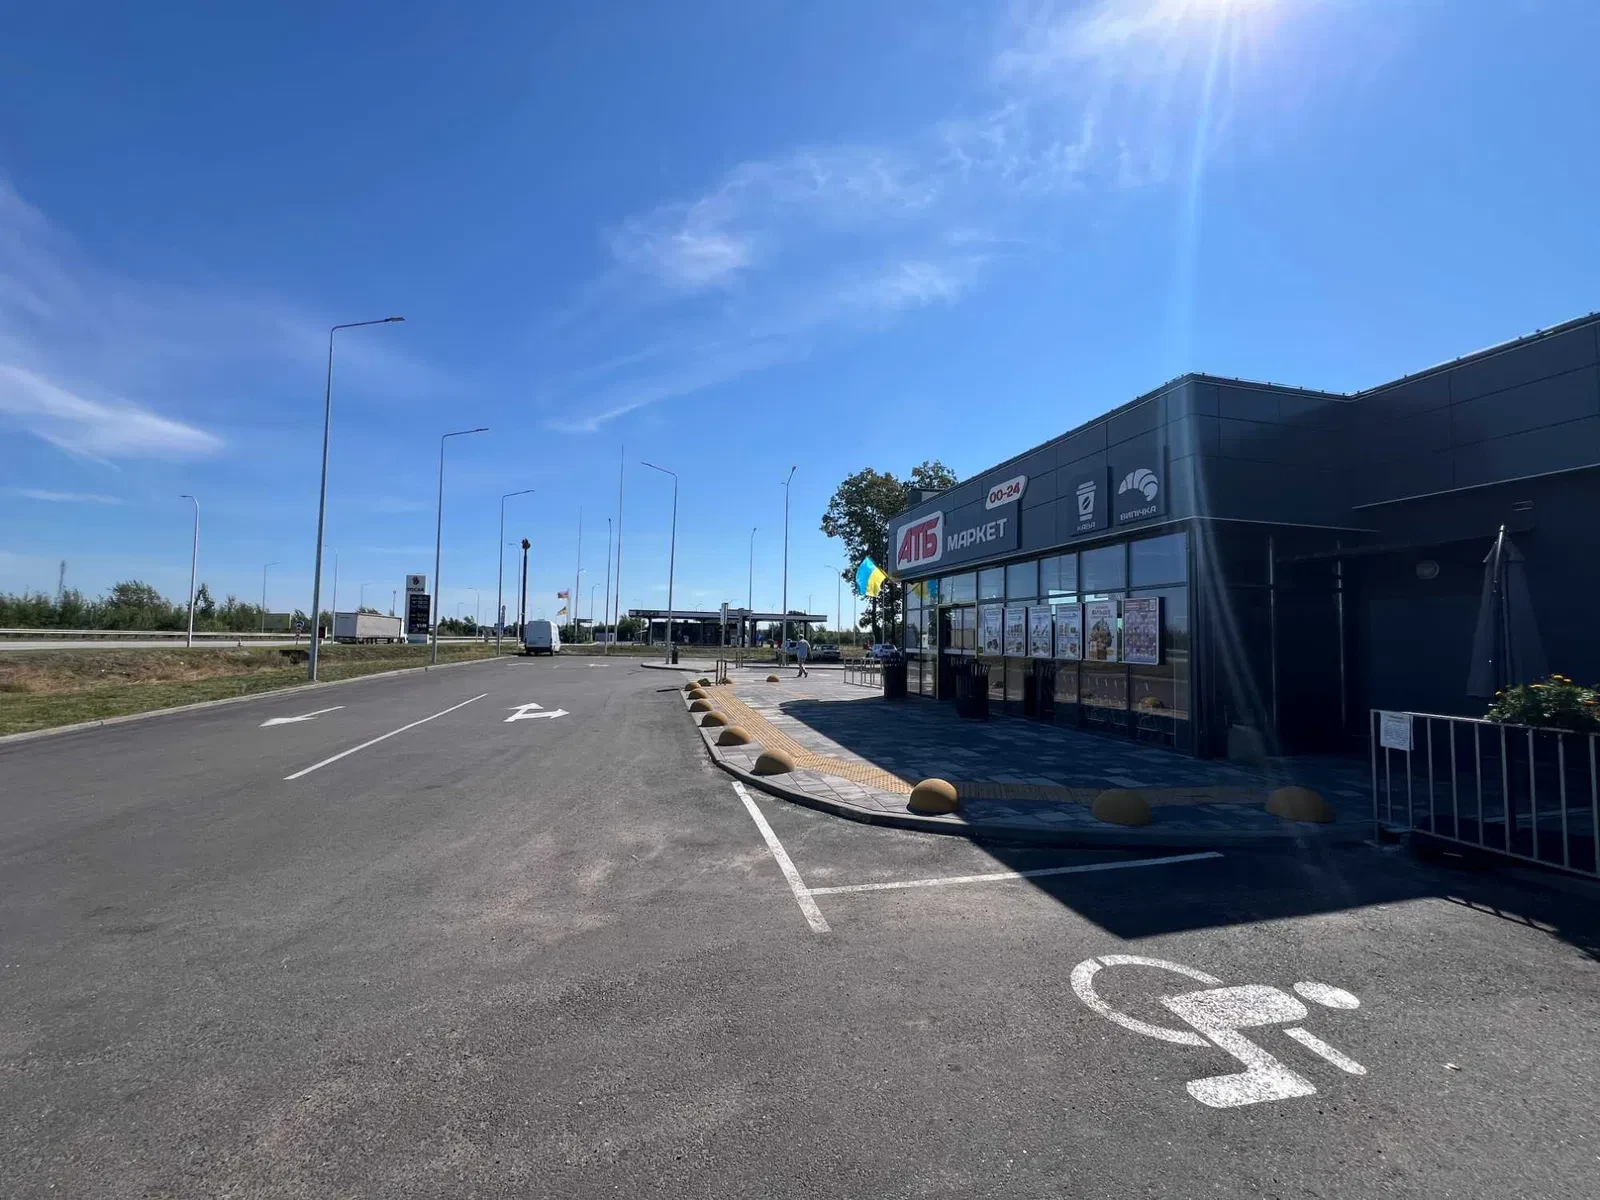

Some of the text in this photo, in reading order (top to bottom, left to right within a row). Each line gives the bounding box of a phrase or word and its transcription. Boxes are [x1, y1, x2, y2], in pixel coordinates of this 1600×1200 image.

[989, 482, 1020, 504] 00-24
[1120, 505, 1157, 521] ВИПІЧКА
[1077, 521, 1096, 532] КАВА
[898, 516, 1008, 565] АТБ МАРКЕТ
